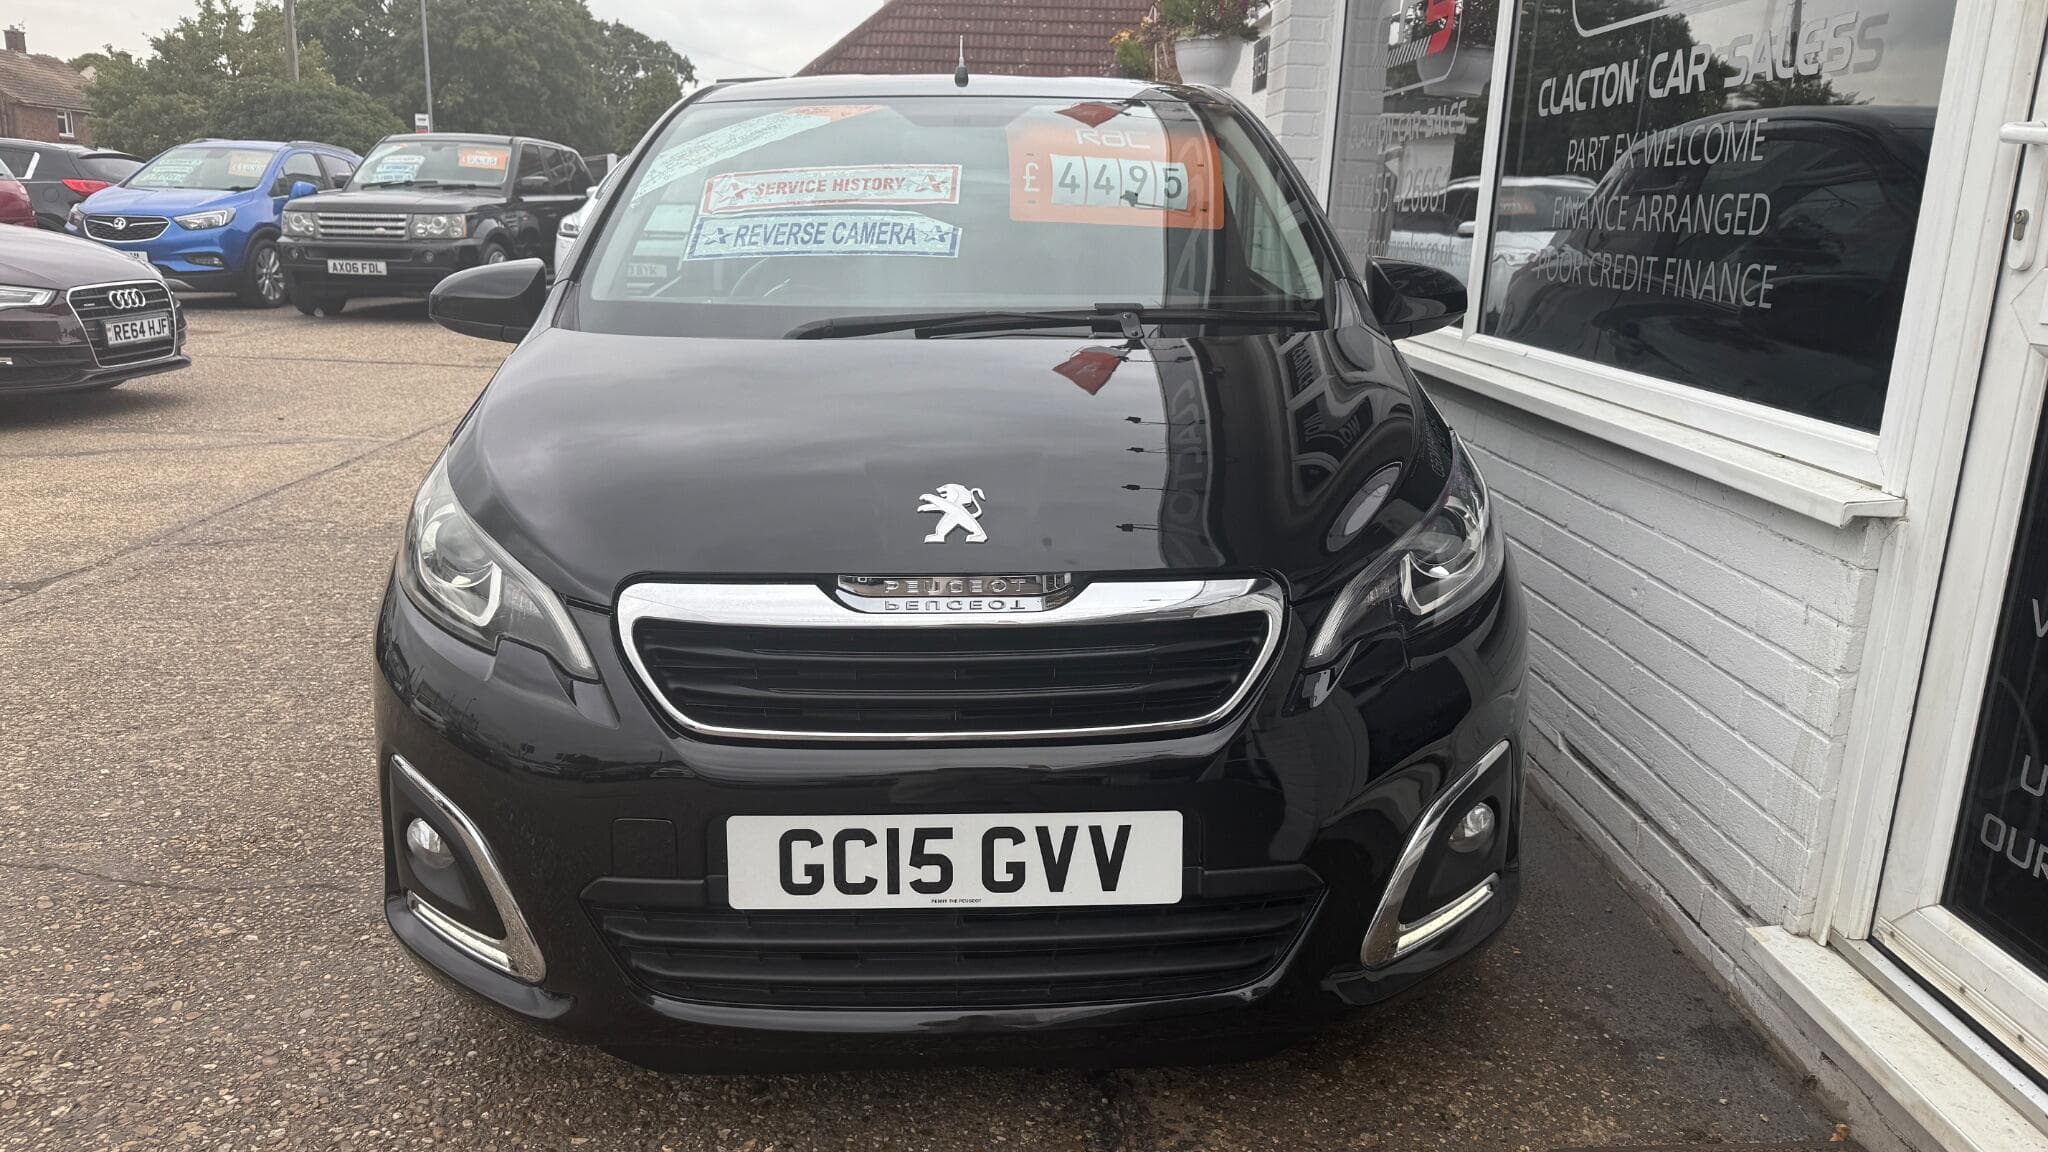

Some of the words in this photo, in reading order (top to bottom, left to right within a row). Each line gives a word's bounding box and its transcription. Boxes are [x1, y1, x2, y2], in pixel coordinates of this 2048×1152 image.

[1538, 59, 1640, 117] CLACTON
[1649, 45, 1712, 99] CAR
[1723, 12, 1860, 88] SALES
[1566, 134, 1610, 172] PART
[1613, 132, 1640, 170] EX
[1643, 117, 1769, 169] WELCOME
[754, 178, 827, 197] SERVICE
[831, 176, 907, 193] HISTORY
[1057, 161, 1183, 200] 4495
[732, 221, 828, 247] REVERSE
[832, 221, 917, 246] CAMERA
[1551, 195, 1630, 232] FINANCE
[1632, 193, 1771, 236] ARRANGED
[332, 262, 359, 273] AX06
[361, 262, 383, 274] FDL
[1536, 250, 1582, 285] POOR
[1588, 253, 1659, 294] CREDIT
[1662, 257, 1778, 309] FINANCE
[113, 321, 146, 341] RE64
[148, 317, 167, 337] HJF
[884, 578, 1027, 594] PEUGEOT
[778, 827, 954, 896] GC15
[981, 824, 1132, 894] GVV
